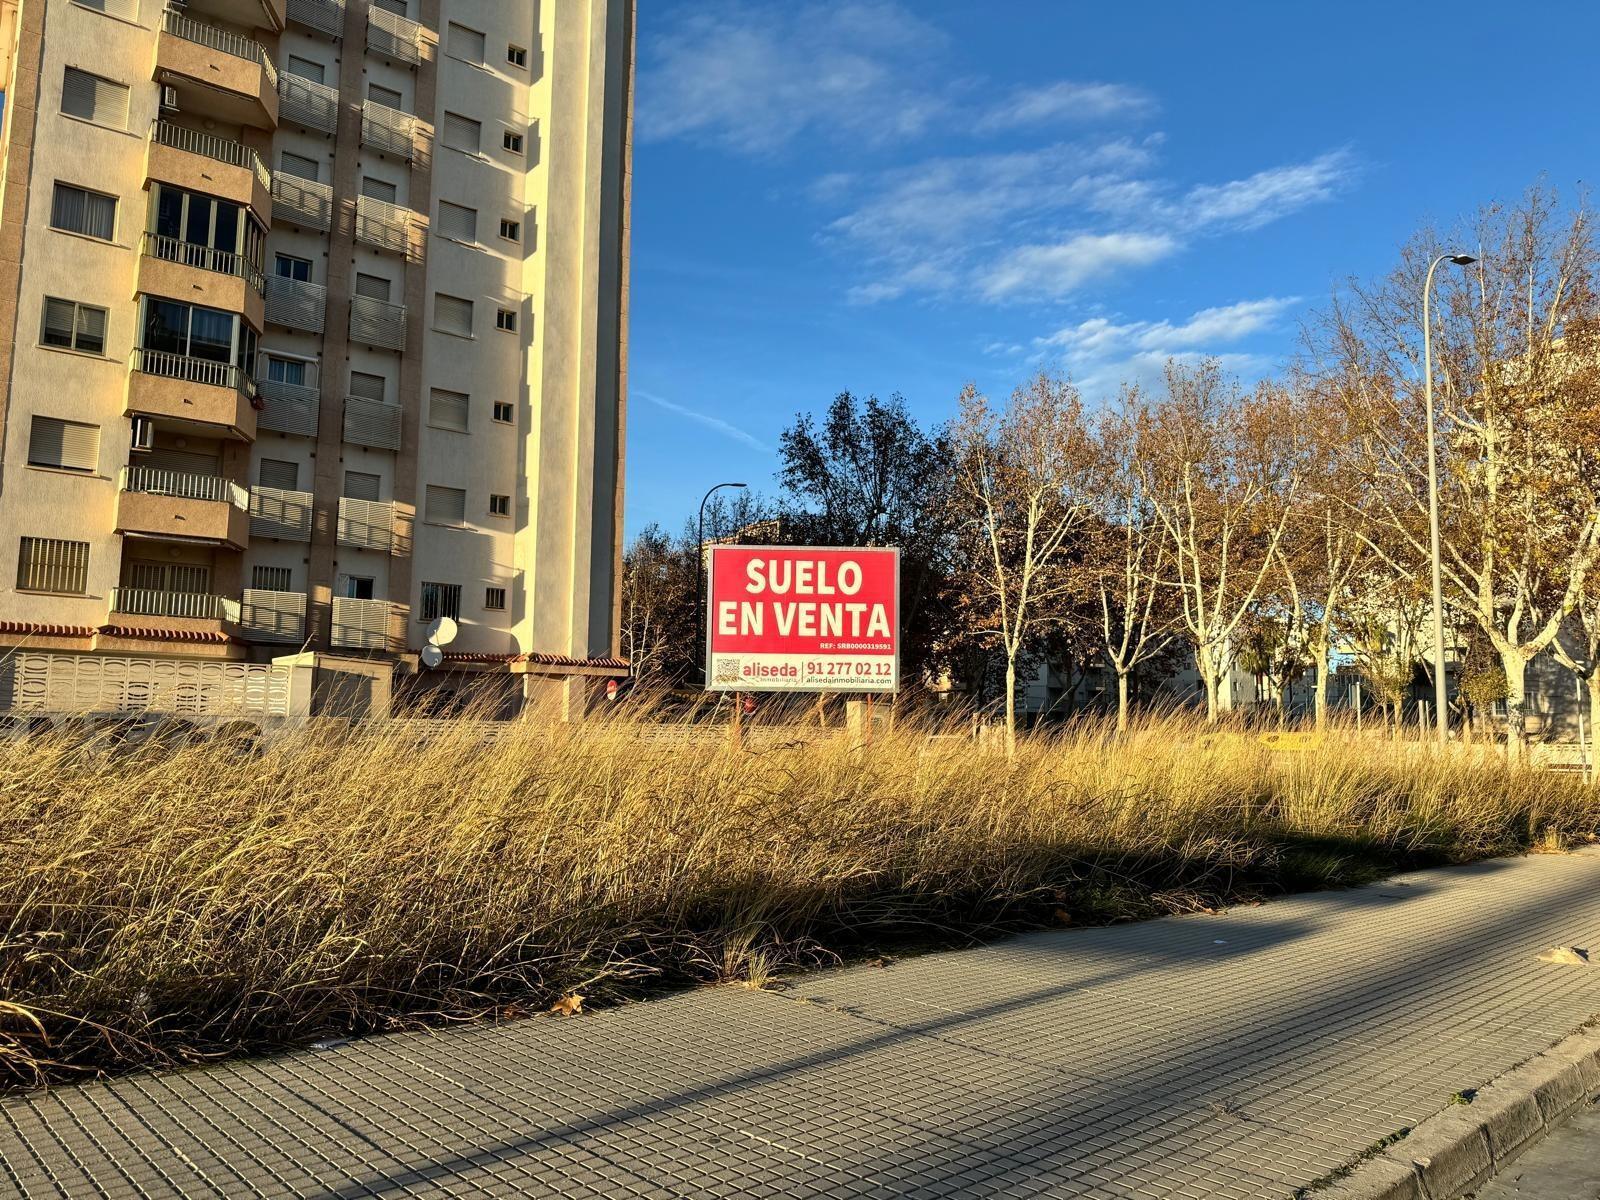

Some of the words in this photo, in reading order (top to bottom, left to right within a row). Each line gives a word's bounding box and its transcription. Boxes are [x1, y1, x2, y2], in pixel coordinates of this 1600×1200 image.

[746, 558, 863, 595] SUELO
[718, 601, 764, 636] EN
[773, 602, 891, 637] VENTA
[743, 662, 797, 677] aliseda
[807, 661, 823, 675] 91
[828, 662, 852, 675] 277
[855, 662, 872, 676] 02
[875, 662, 892, 676] 12
[806, 676, 892, 685] alisedainmobiliaria.com
